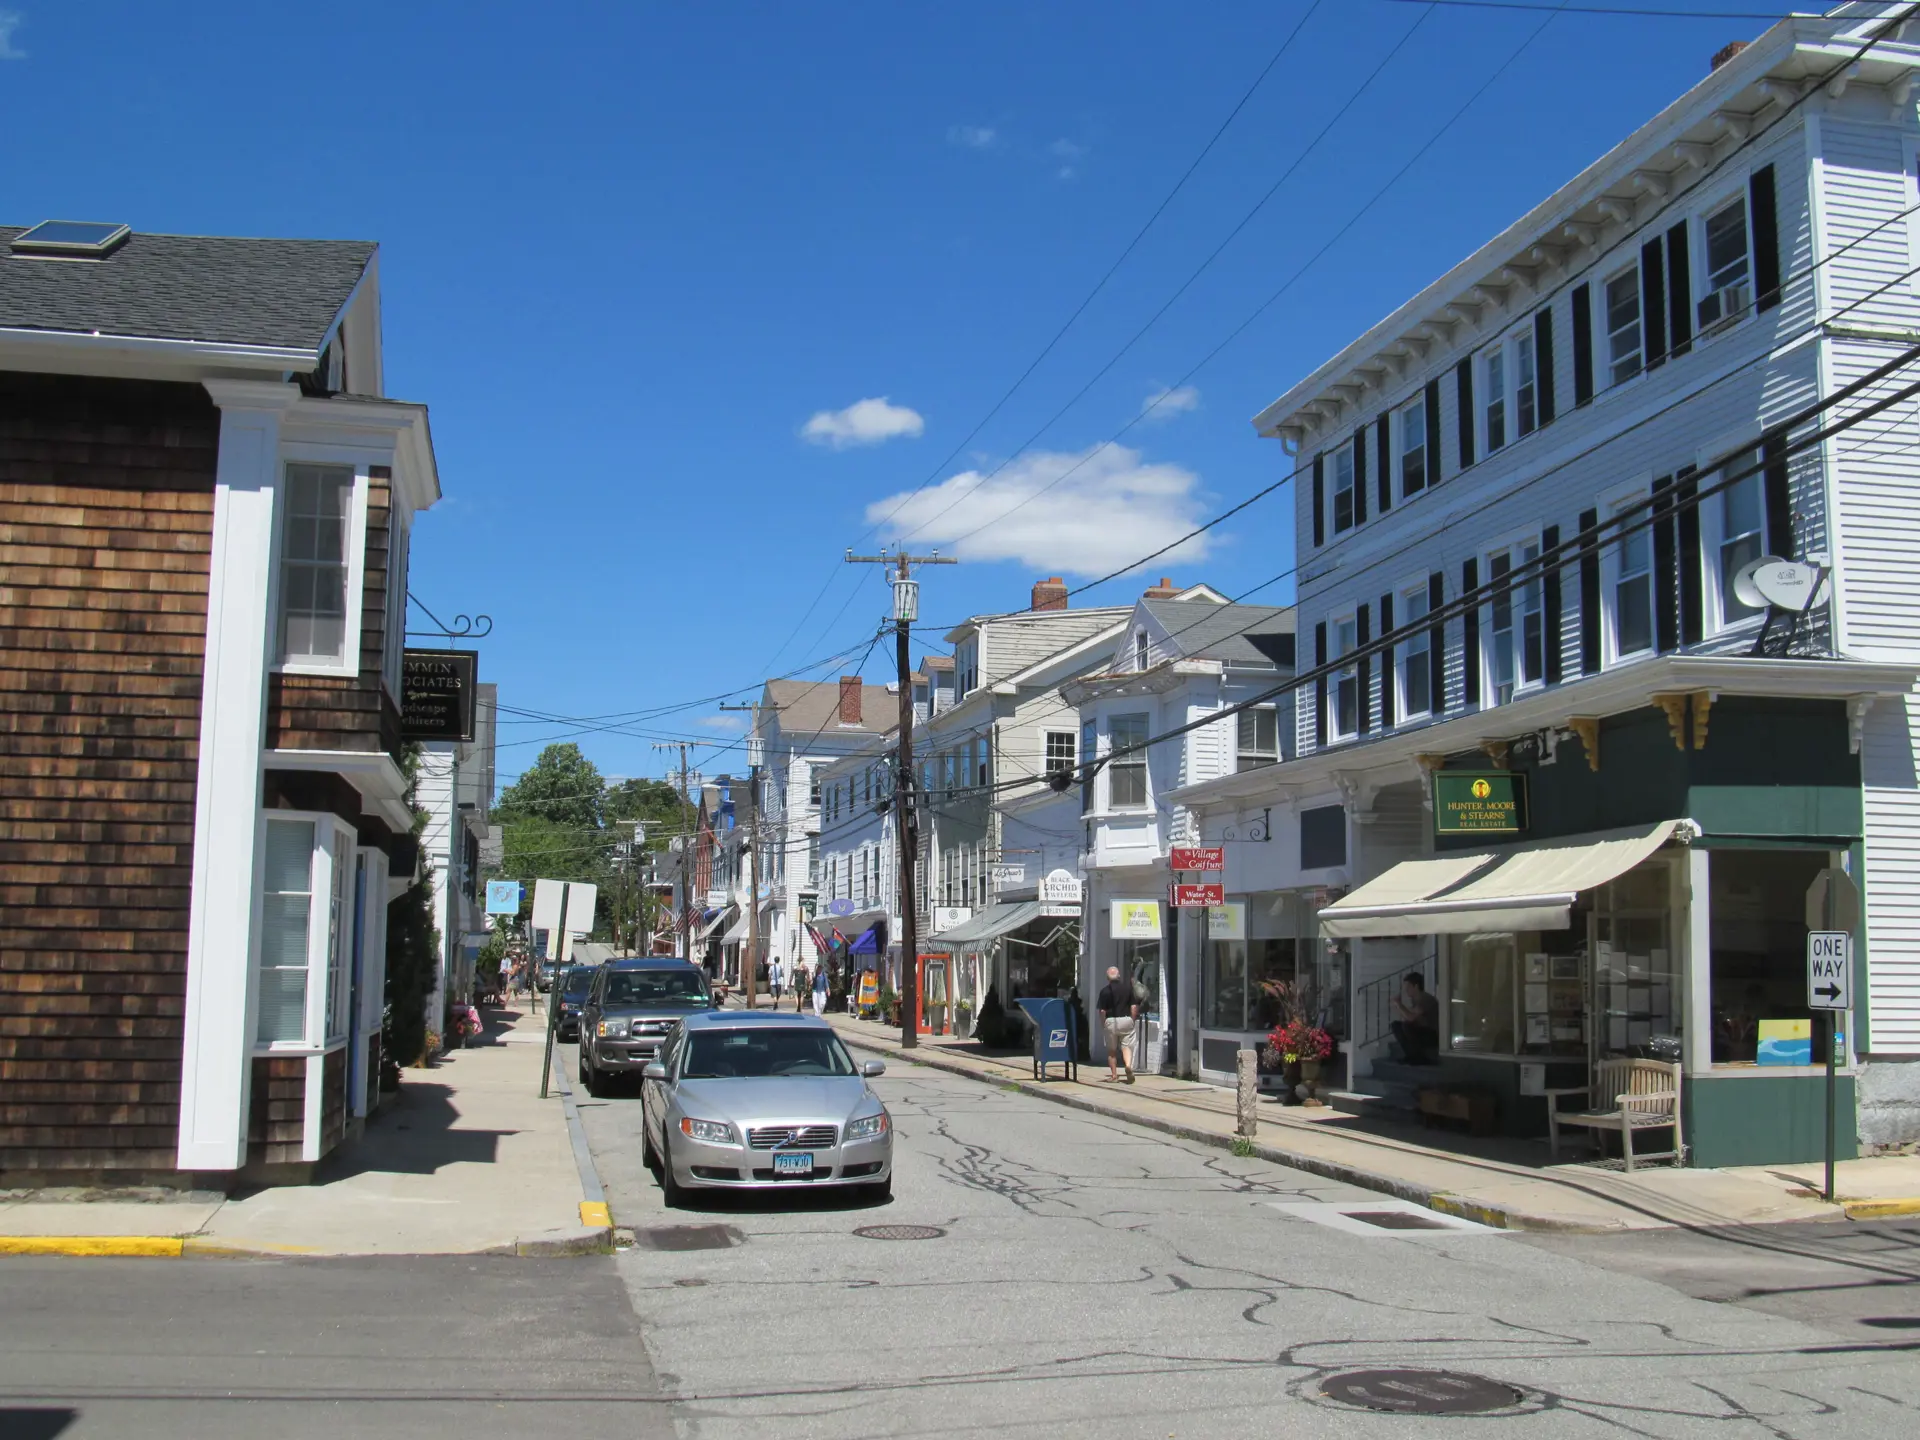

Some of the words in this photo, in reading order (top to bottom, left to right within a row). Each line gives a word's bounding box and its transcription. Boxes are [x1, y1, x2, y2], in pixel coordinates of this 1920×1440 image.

[1486, 801, 1516, 811] MOORE
[1460, 811, 1467, 820] &
[1468, 811, 1505, 820] STEARNS
[1480, 820, 1506, 828] ESTATE
[1192, 849, 1220, 861] Village
[1188, 859, 1223, 871] Coiffure
[1044, 883, 1078, 892] ORCHID
[1185, 890, 1206, 898] Water
[1207, 890, 1216, 898] St.
[1204, 898, 1221, 906] Shop
[1813, 939, 1843, 957] ONE
[1812, 960, 1843, 978] WAY
